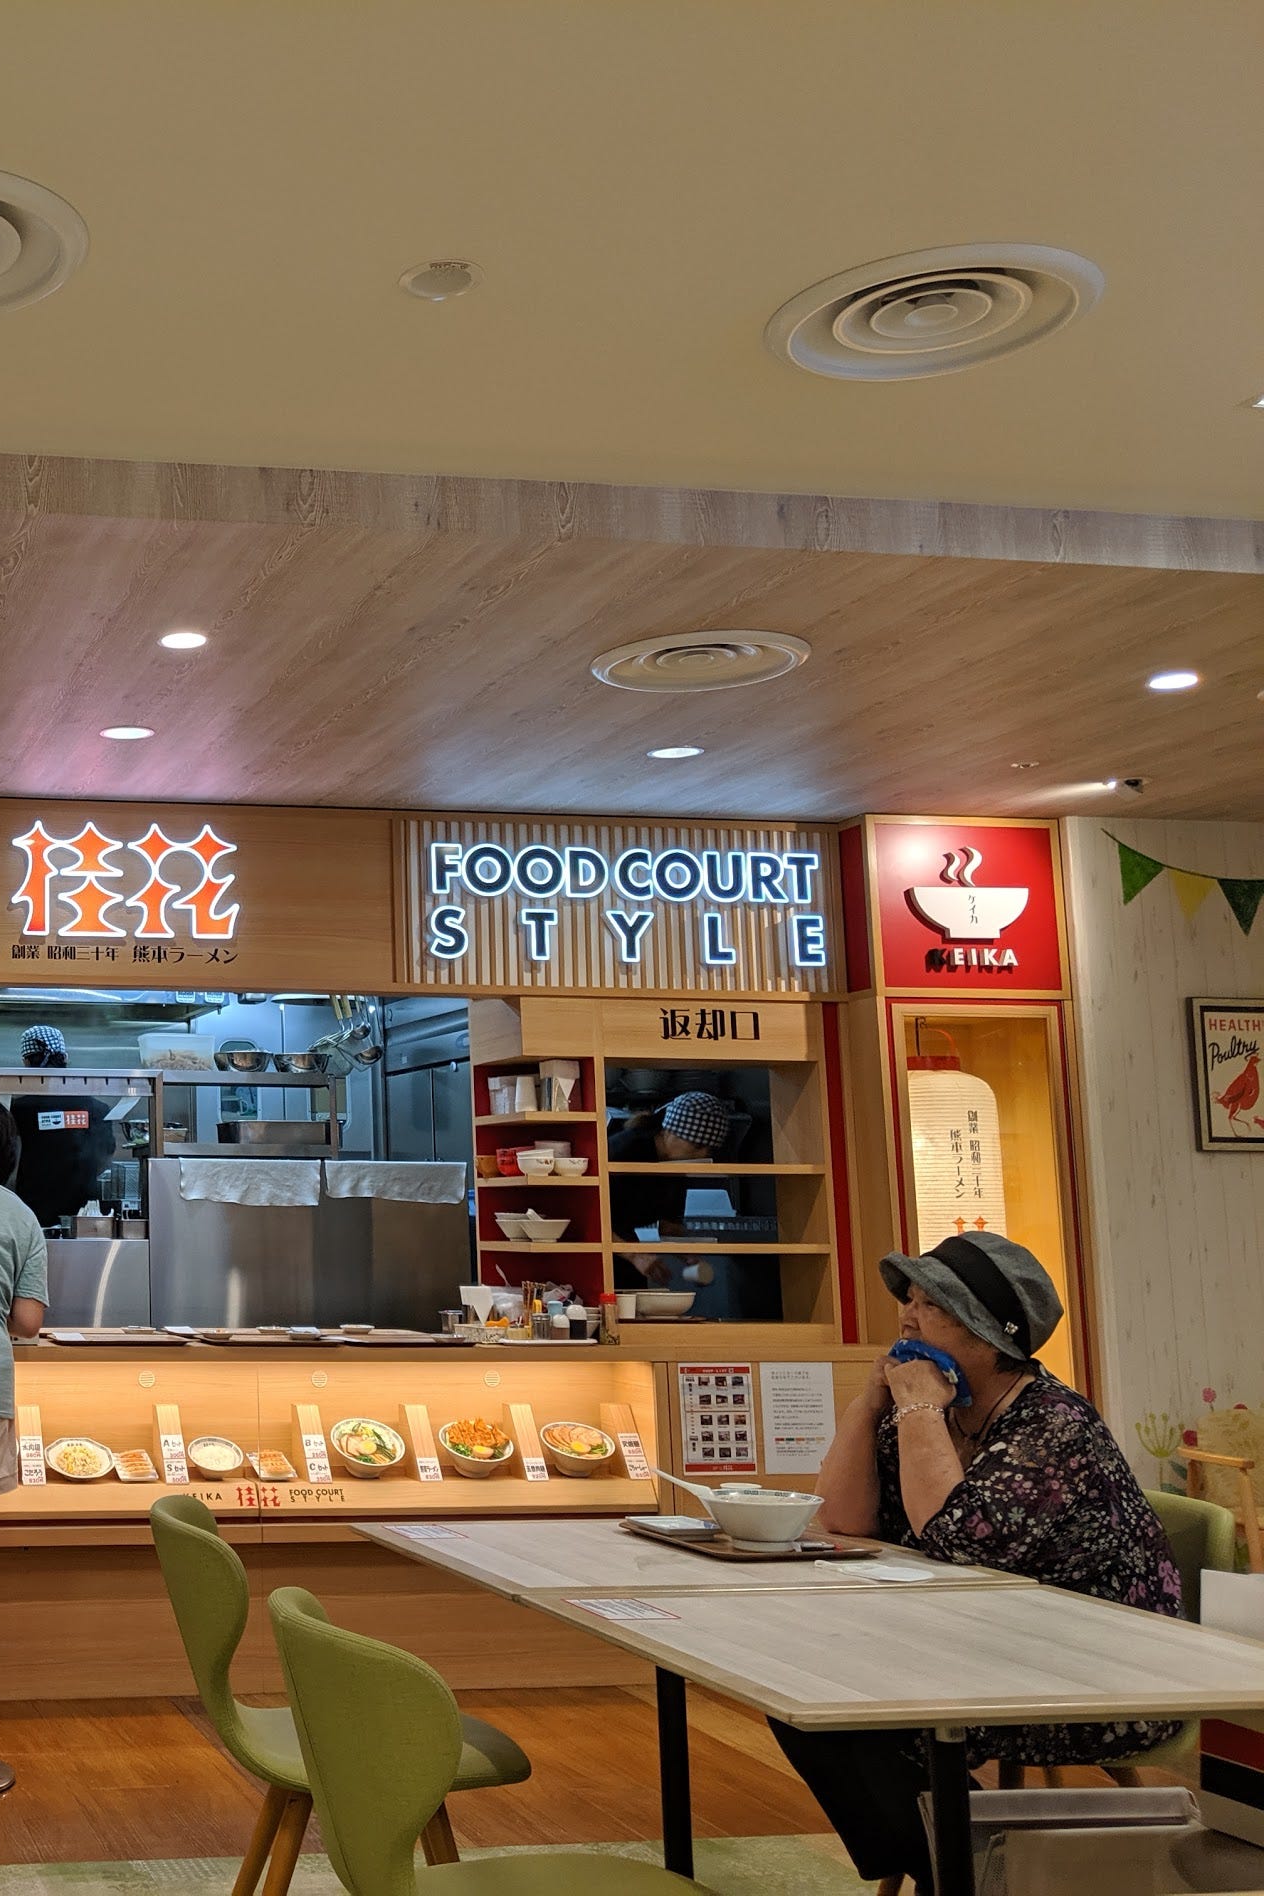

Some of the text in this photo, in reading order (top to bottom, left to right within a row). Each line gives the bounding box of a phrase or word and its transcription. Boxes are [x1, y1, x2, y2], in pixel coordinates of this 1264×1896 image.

[11, 820, 240, 940] 桂花
[431, 842, 818, 904] FOOD COURT
[431, 905, 826, 967] STYLE
[11, 944, 238, 964] 創業 昭和三十年 熊本ラーメン
[925, 947, 1019, 968] KEIKA
[659, 1007, 761, 1041] 返却口
[1208, 1018, 1264, 1032] HEALTH
[1208, 1036, 1260, 1071] Poultry
[950, 1129, 966, 1199] 熊本ラーメン
[315, 1488, 344, 1496] COURT
